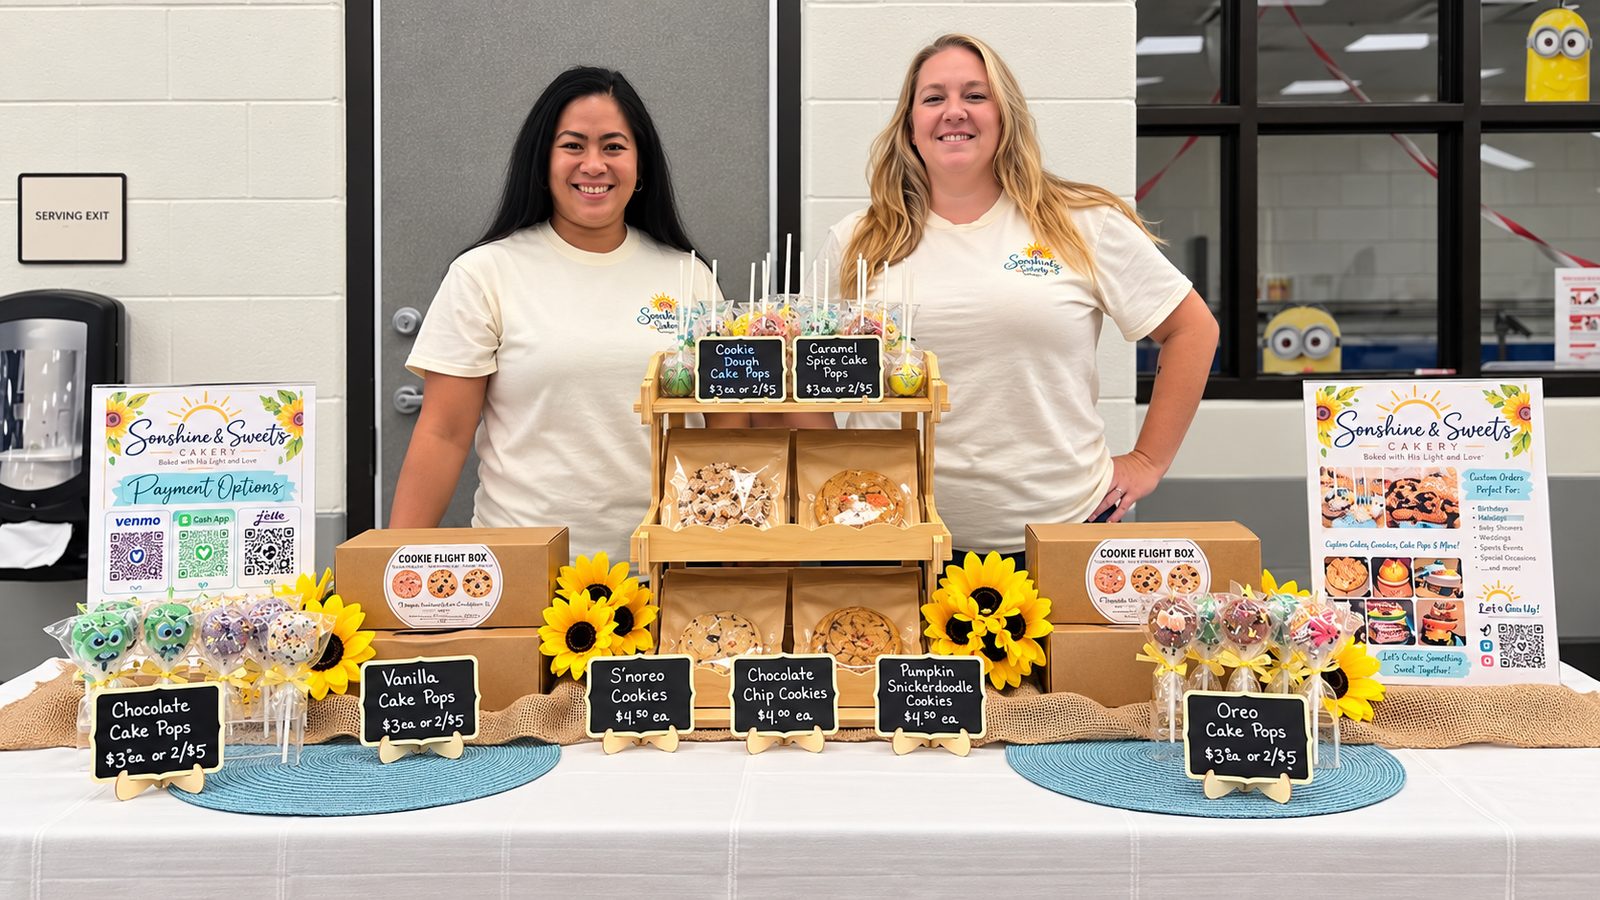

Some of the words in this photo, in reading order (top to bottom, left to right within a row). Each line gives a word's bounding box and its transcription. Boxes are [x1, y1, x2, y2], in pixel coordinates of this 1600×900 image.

[35, 211, 83, 220] SERVING
[86, 211, 109, 220] EXIT
[715, 344, 755, 355] Cookie
[810, 343, 857, 354] Caramel
[724, 357, 760, 368] Dough
[806, 356, 835, 370] Spice
[841, 356, 868, 365] Cake
[710, 368, 739, 379] Cake
[746, 367, 770, 381] Pops
[823, 368, 848, 382] Pops
[752, 383, 776, 396] 2/$5
[848, 382, 872, 395] 2/$5
[1334, 410, 1425, 448] Sonshine
[1429, 422, 1440, 437] &
[1443, 412, 1518, 442] Sweets
[125, 419, 211, 456] Sonshine
[213, 428, 224, 446] &
[226, 420, 291, 447] Sweets
[180, 448, 236, 456] CAKERY
[1388, 442, 1458, 451] CAKERY
[1423, 453, 1444, 462] Light
[1500, 473, 1524, 481] Orders
[127, 474, 215, 505] Payment
[218, 474, 284, 500] Options
[1505, 486, 1520, 494] For:
[115, 516, 161, 527] venmo
[193, 515, 212, 523] Cash
[213, 515, 229, 525] App
[1417, 541, 1431, 551] Pops
[399, 554, 432, 563] COOKIE
[434, 554, 465, 563] FLIGHT
[468, 554, 487, 562] BOX
[1100, 549, 1136, 558] COOKIE
[1139, 549, 1171, 558] FLIGHT
[1174, 549, 1194, 558] BOX
[1480, 554, 1503, 562] Special
[1383, 652, 1399, 661] Let's
[1402, 653, 1423, 662] Create
[1426, 653, 1462, 665] Something
[382, 668, 439, 687] Vanilla
[610, 667, 665, 684] S'noreo
[748, 666, 814, 682] Chocolate
[900, 663, 954, 682] Pumpkin
[888, 679, 974, 693] Snickerdoodle
[379, 692, 416, 708] Cake
[423, 689, 456, 709] Pops
[611, 688, 668, 703] Cookies
[744, 687, 774, 706] Chip
[779, 686, 827, 700] Cookies
[906, 694, 952, 707] Cookies
[112, 697, 191, 718] Chocolate
[1217, 702, 1258, 719] Oreo
[435, 711, 464, 731] 2/$5
[653, 713, 670, 722] ea
[796, 712, 813, 721] ea
[942, 715, 959, 724] ea
[110, 724, 149, 740] Cake
[156, 720, 191, 741] Pops
[1206, 722, 1244, 738] Cake
[1251, 722, 1286, 744] Pops
[152, 751, 166, 761] or
[171, 741, 206, 763] 2/$5
[1247, 752, 1260, 761] or
[1264, 747, 1296, 767] 2/$5
